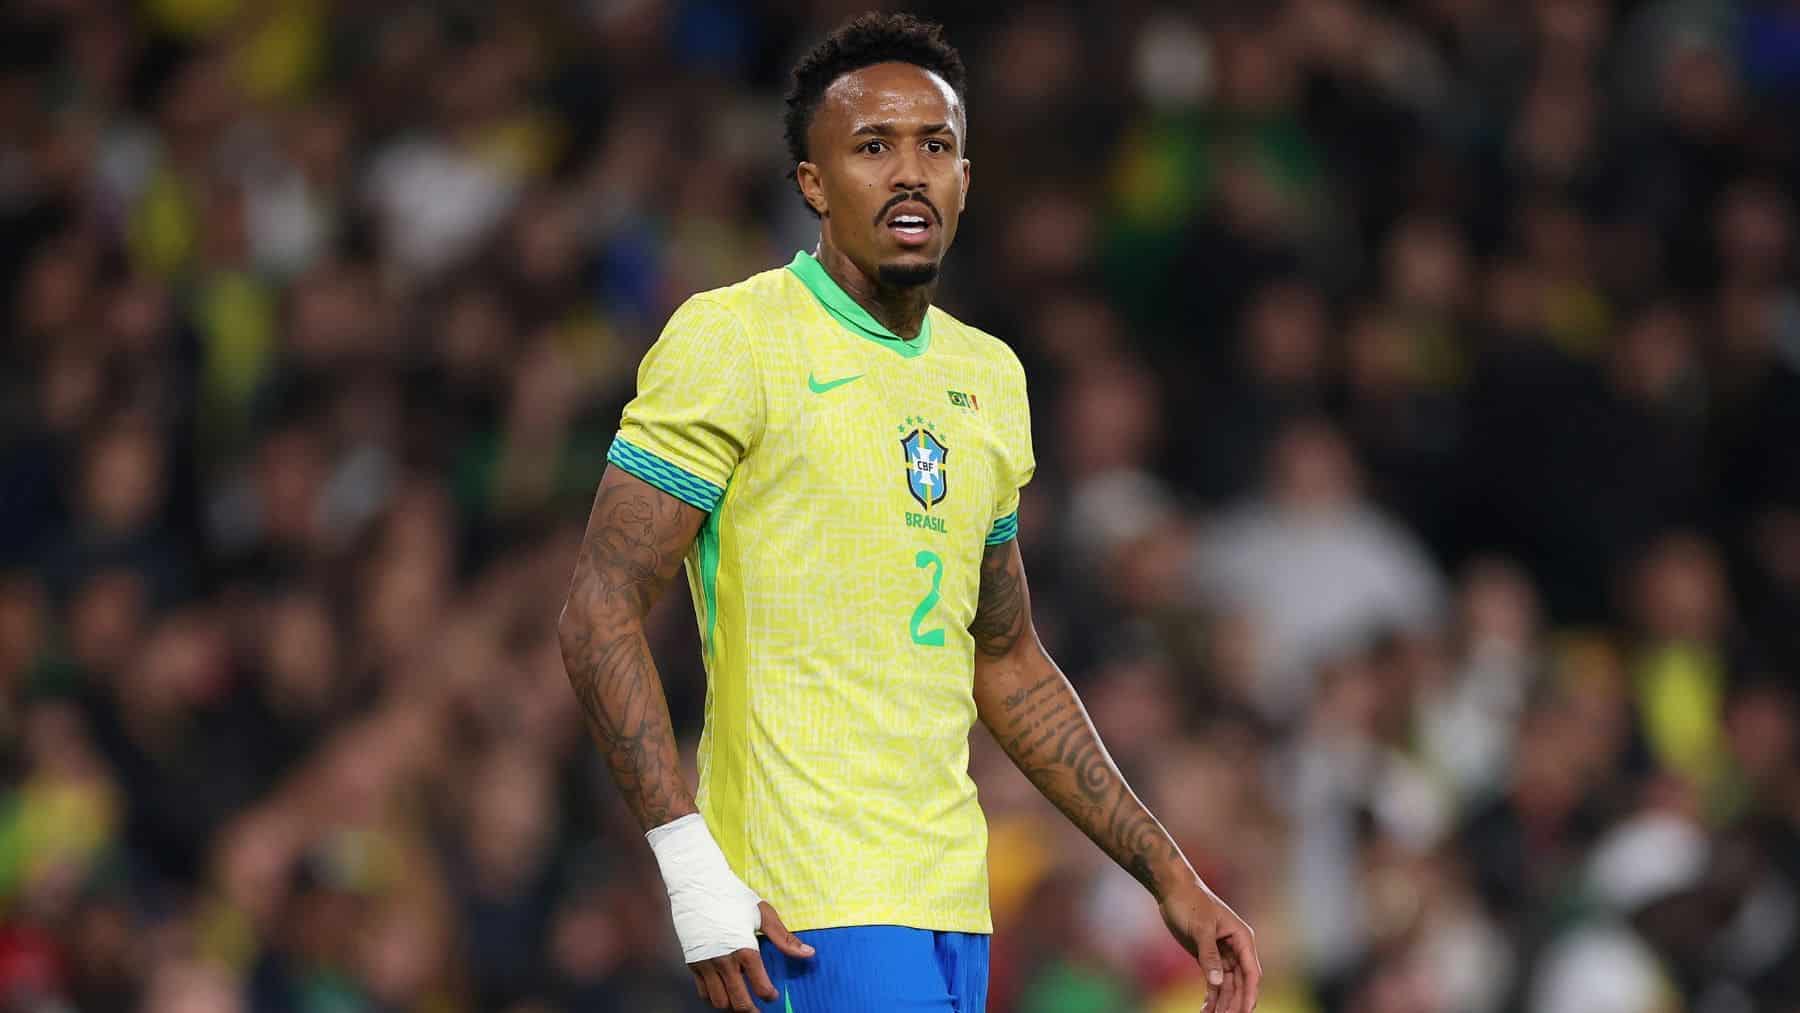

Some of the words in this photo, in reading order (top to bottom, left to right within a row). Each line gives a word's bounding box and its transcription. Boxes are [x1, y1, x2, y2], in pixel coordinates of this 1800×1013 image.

[917, 460, 934, 472] CBF
[905, 511, 948, 534] BRASIL
[910, 550, 945, 647] 2
